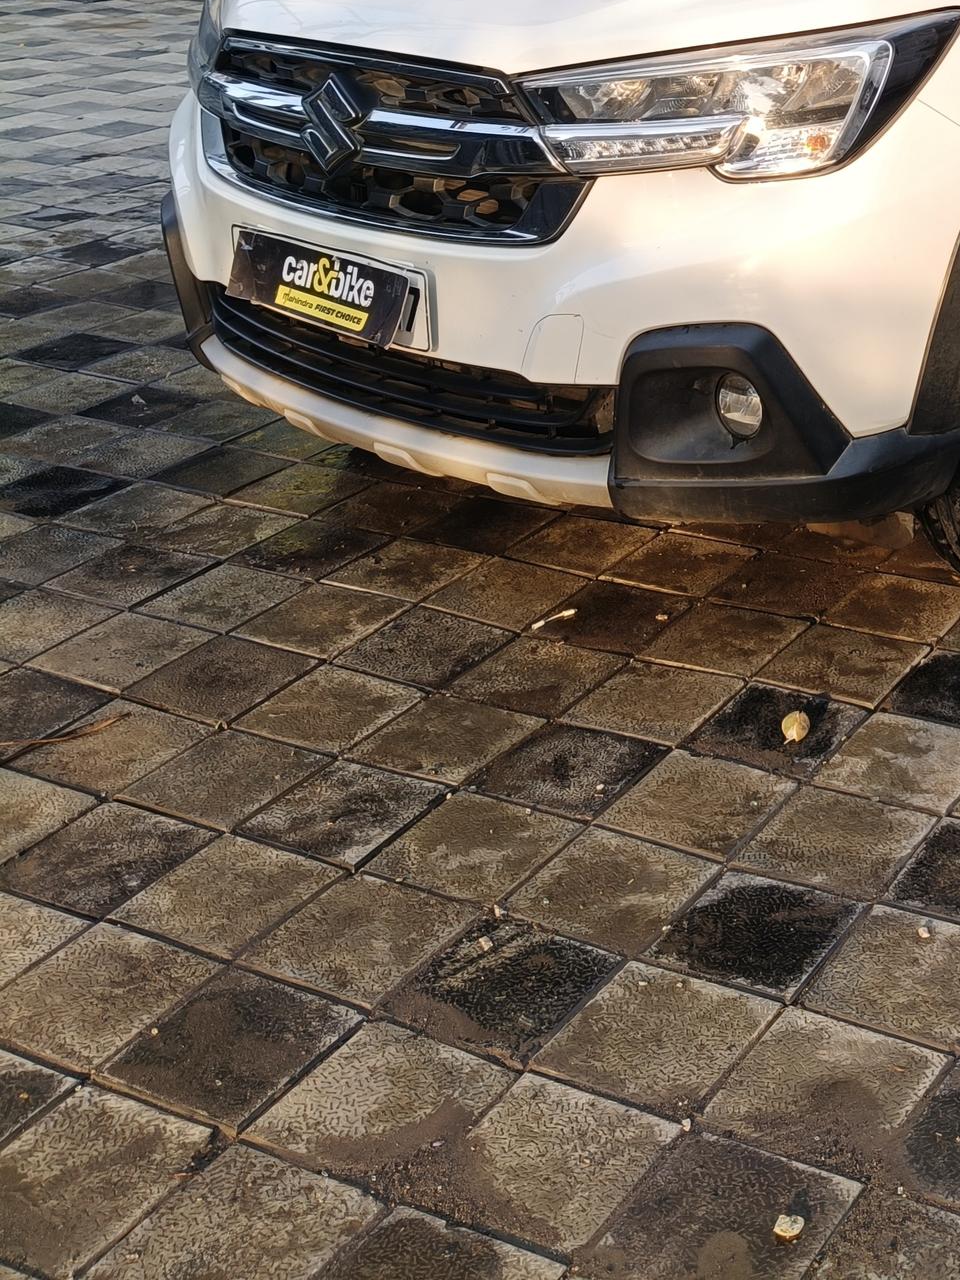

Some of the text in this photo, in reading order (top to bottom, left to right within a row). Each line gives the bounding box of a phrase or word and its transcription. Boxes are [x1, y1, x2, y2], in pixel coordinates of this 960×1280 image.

[281, 255, 375, 308] car&bike
[282, 290, 363, 325] Mahindra FIRST CHOICE
